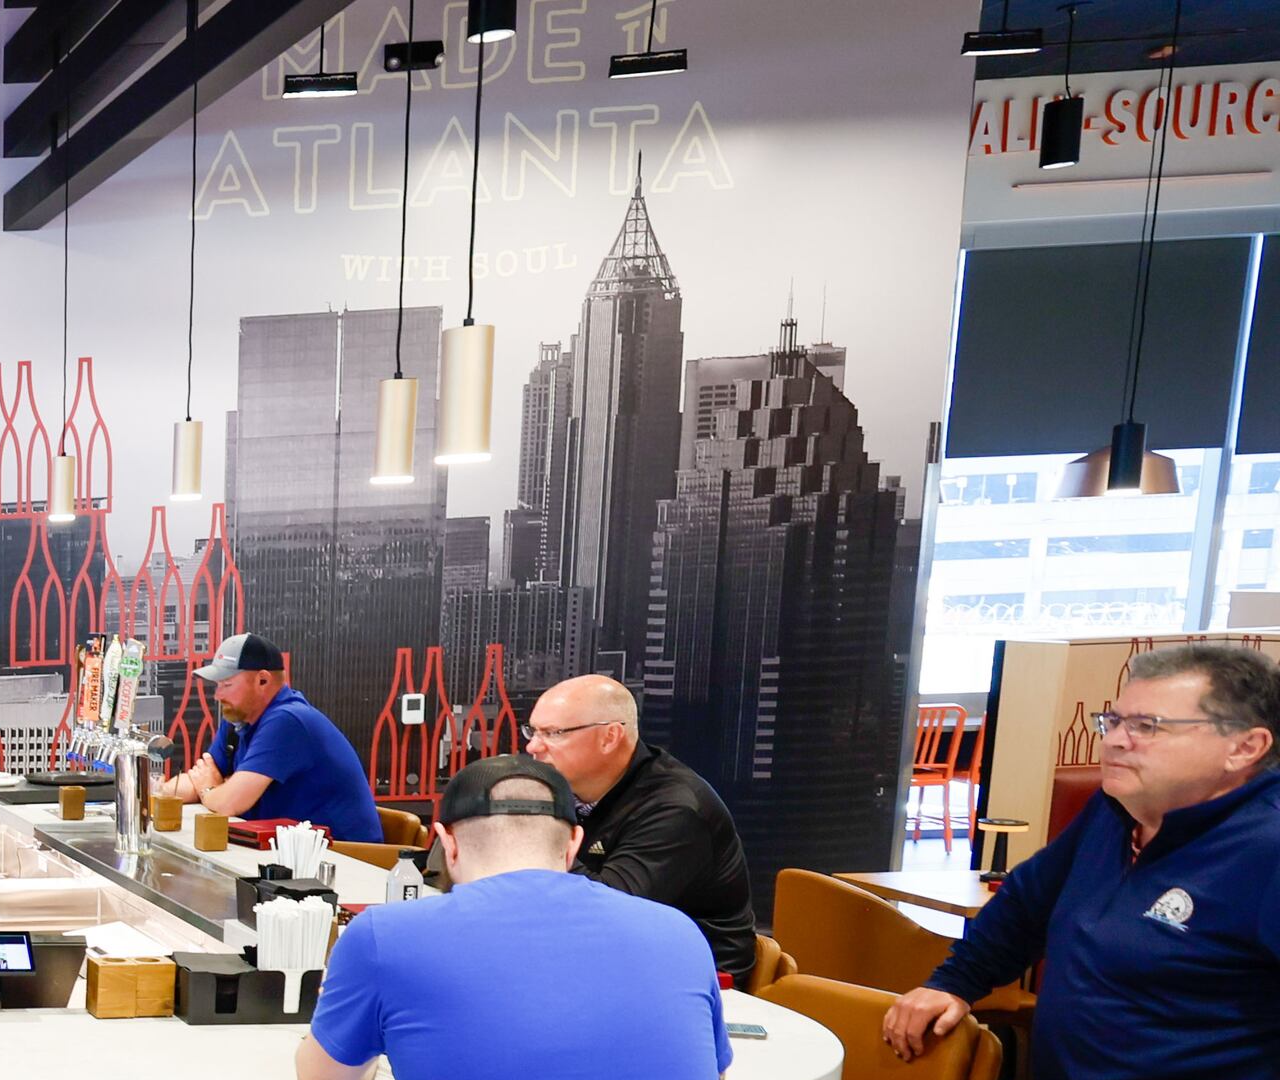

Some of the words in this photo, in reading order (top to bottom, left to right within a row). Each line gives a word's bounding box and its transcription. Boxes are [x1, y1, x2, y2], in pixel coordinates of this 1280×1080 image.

[263, 0, 586, 100] MADE
[188, 101, 734, 220] ATLANTA
[341, 249, 451, 283] WITH
[471, 242, 578, 278] SOUL
[91, 667, 99, 683] FIRE
[90, 686, 98, 712] MAKER
[120, 679, 132, 720] SCOFFLAW
